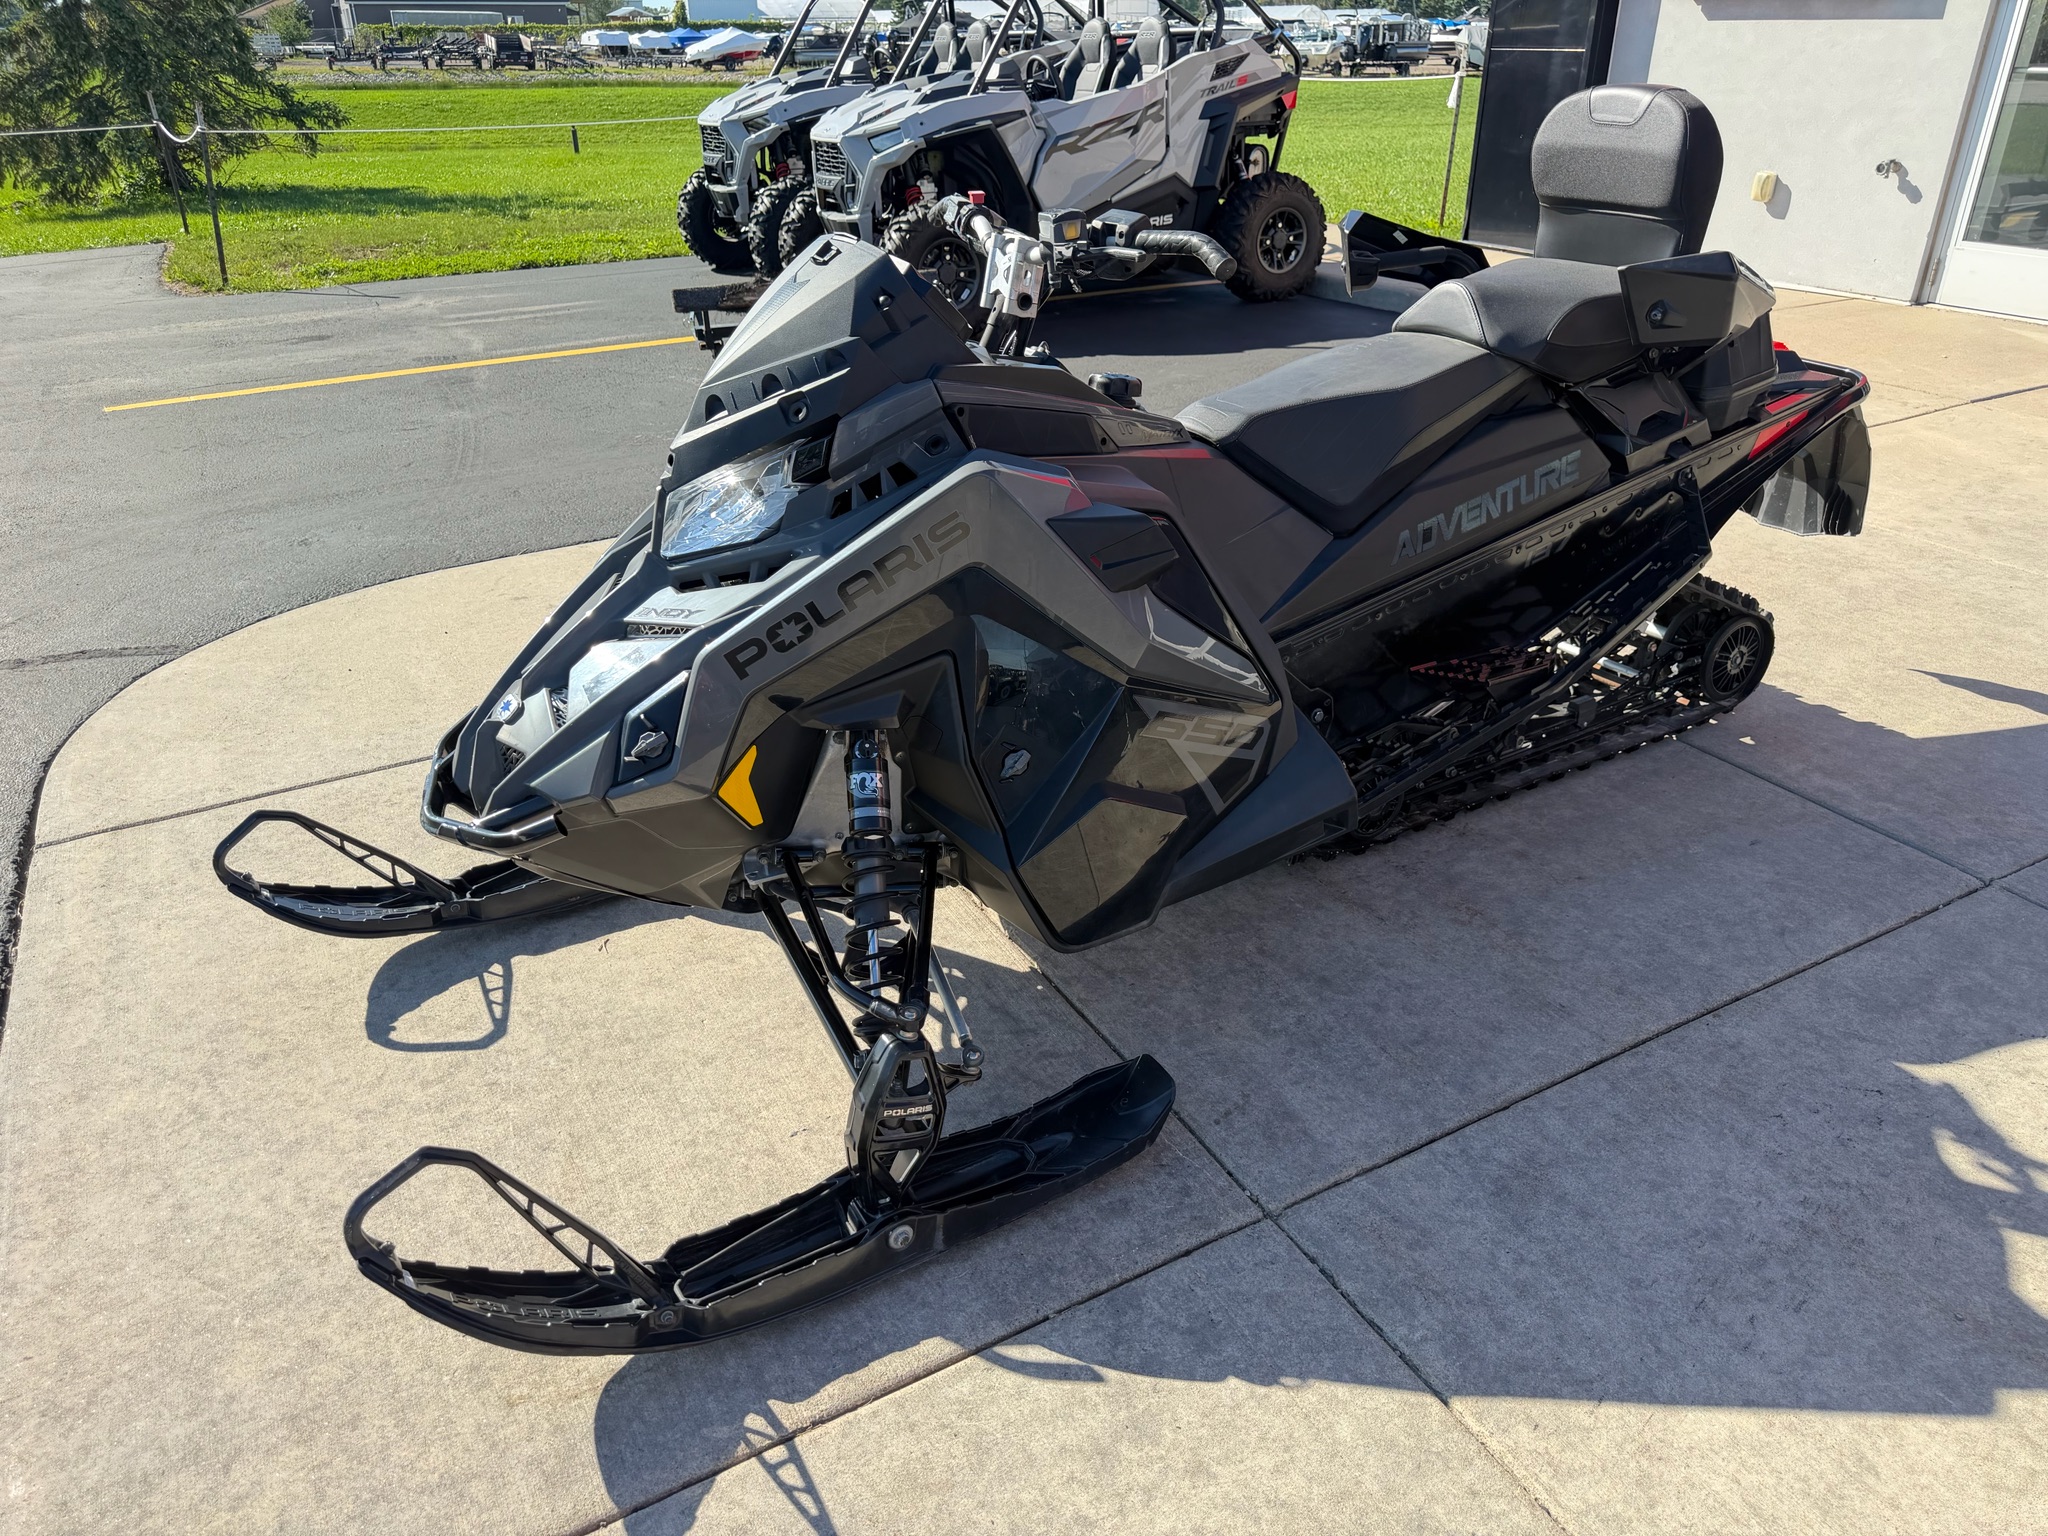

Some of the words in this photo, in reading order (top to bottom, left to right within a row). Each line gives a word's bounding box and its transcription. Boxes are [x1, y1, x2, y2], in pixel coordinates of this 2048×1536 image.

[1200, 80, 1235, 98] TRAIL
[1043, 97, 1165, 165] RZR
[1391, 449, 1581, 566] ADVENTURE
[723, 510, 971, 681] POLARIS
[634, 607, 706, 619] INDY
[849, 772, 884, 798] FOX
[884, 1104, 933, 1117] POLARIS
